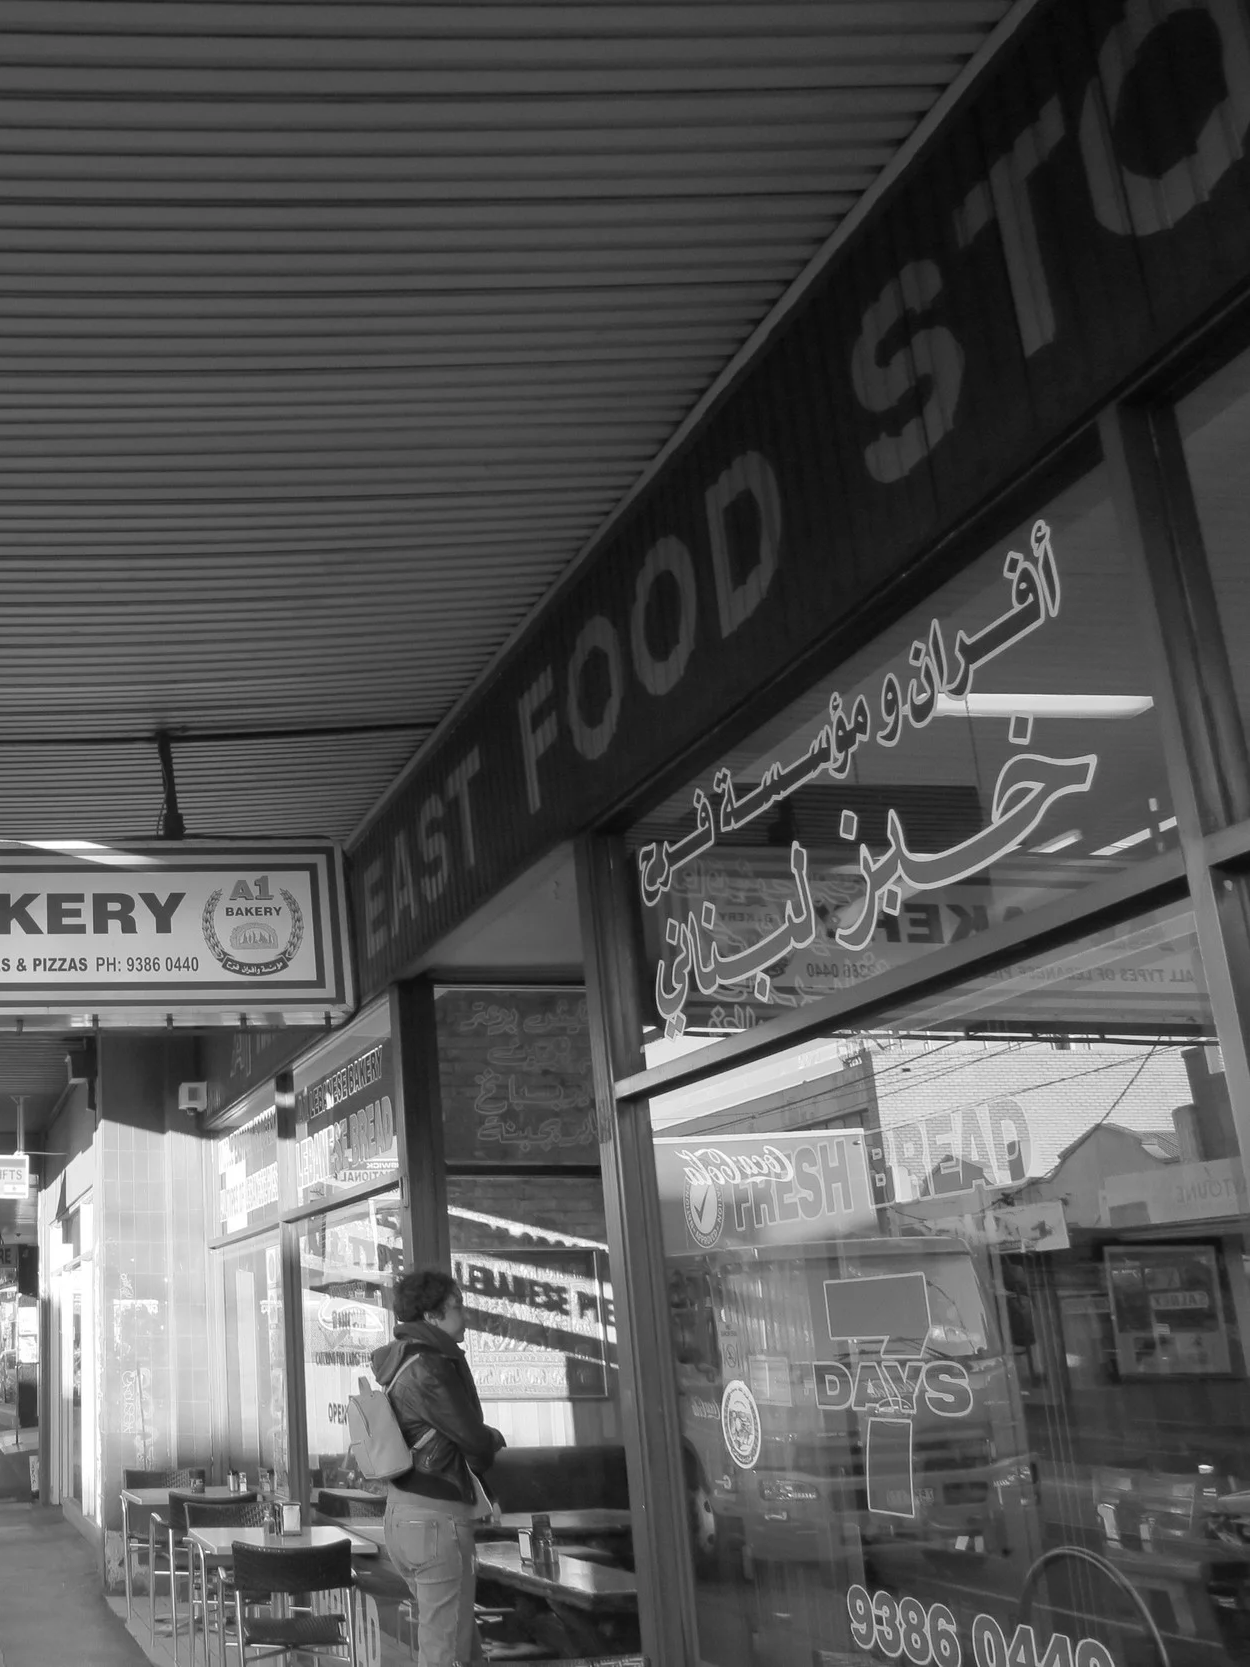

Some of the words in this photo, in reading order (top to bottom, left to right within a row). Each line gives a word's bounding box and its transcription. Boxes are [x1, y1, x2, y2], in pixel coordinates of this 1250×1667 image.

[361, 731, 488, 960] EAST
[517, 449, 782, 814] FOOD
[835, 711, 1098, 951] خبز
[225, 906, 283, 917] BAKERY
[229, 875, 274, 901] A1
[15, 958, 27, 972] &
[32, 957, 88, 972] PIZZAS
[95, 957, 122, 972] PH:
[126, 957, 161, 972] 9386
[165, 956, 199, 972] 0440
[308, 1067, 348, 1119] LEBANESE
[347, 1044, 383, 1096] BAKERY
[349, 1096, 394, 1167] BREAD
[730, 1137, 855, 1232] FRESH
[862, 1098, 1033, 1210] BREAD
[327, 1402, 349, 1425] OPEN
[812, 1360, 974, 1417] DAYS
[846, 1584, 961, 1667] 9386
